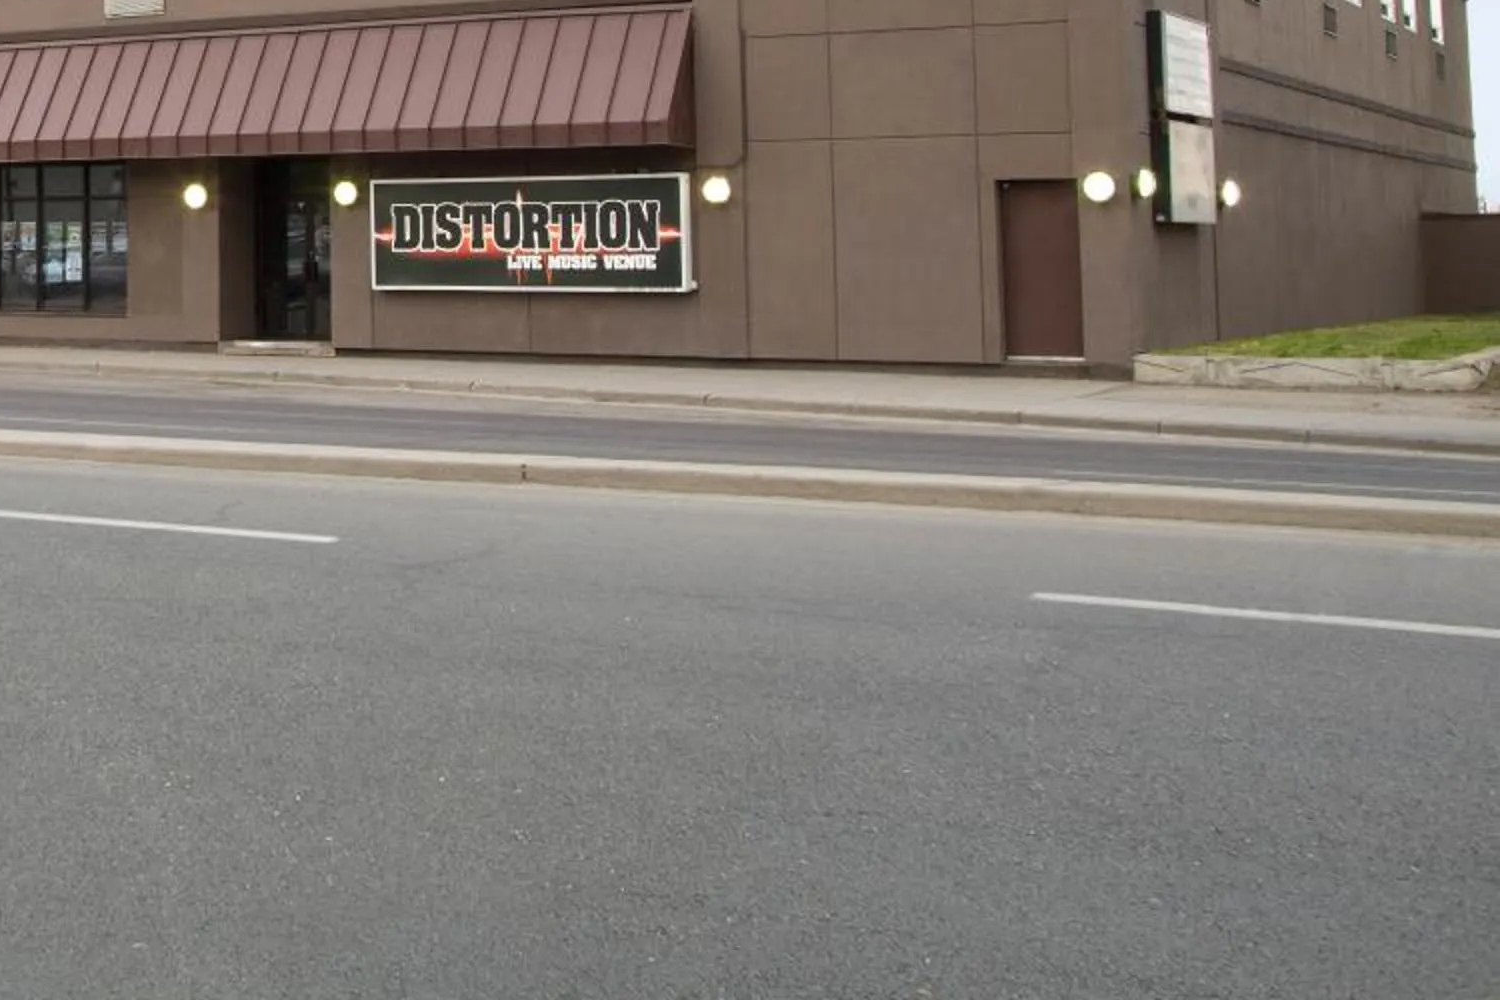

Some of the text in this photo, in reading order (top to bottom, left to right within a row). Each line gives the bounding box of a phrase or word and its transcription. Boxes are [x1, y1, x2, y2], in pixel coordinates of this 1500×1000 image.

[391, 199, 660, 253] DISTORTION
[507, 253, 657, 270] LIVE MUSIC VENUE
